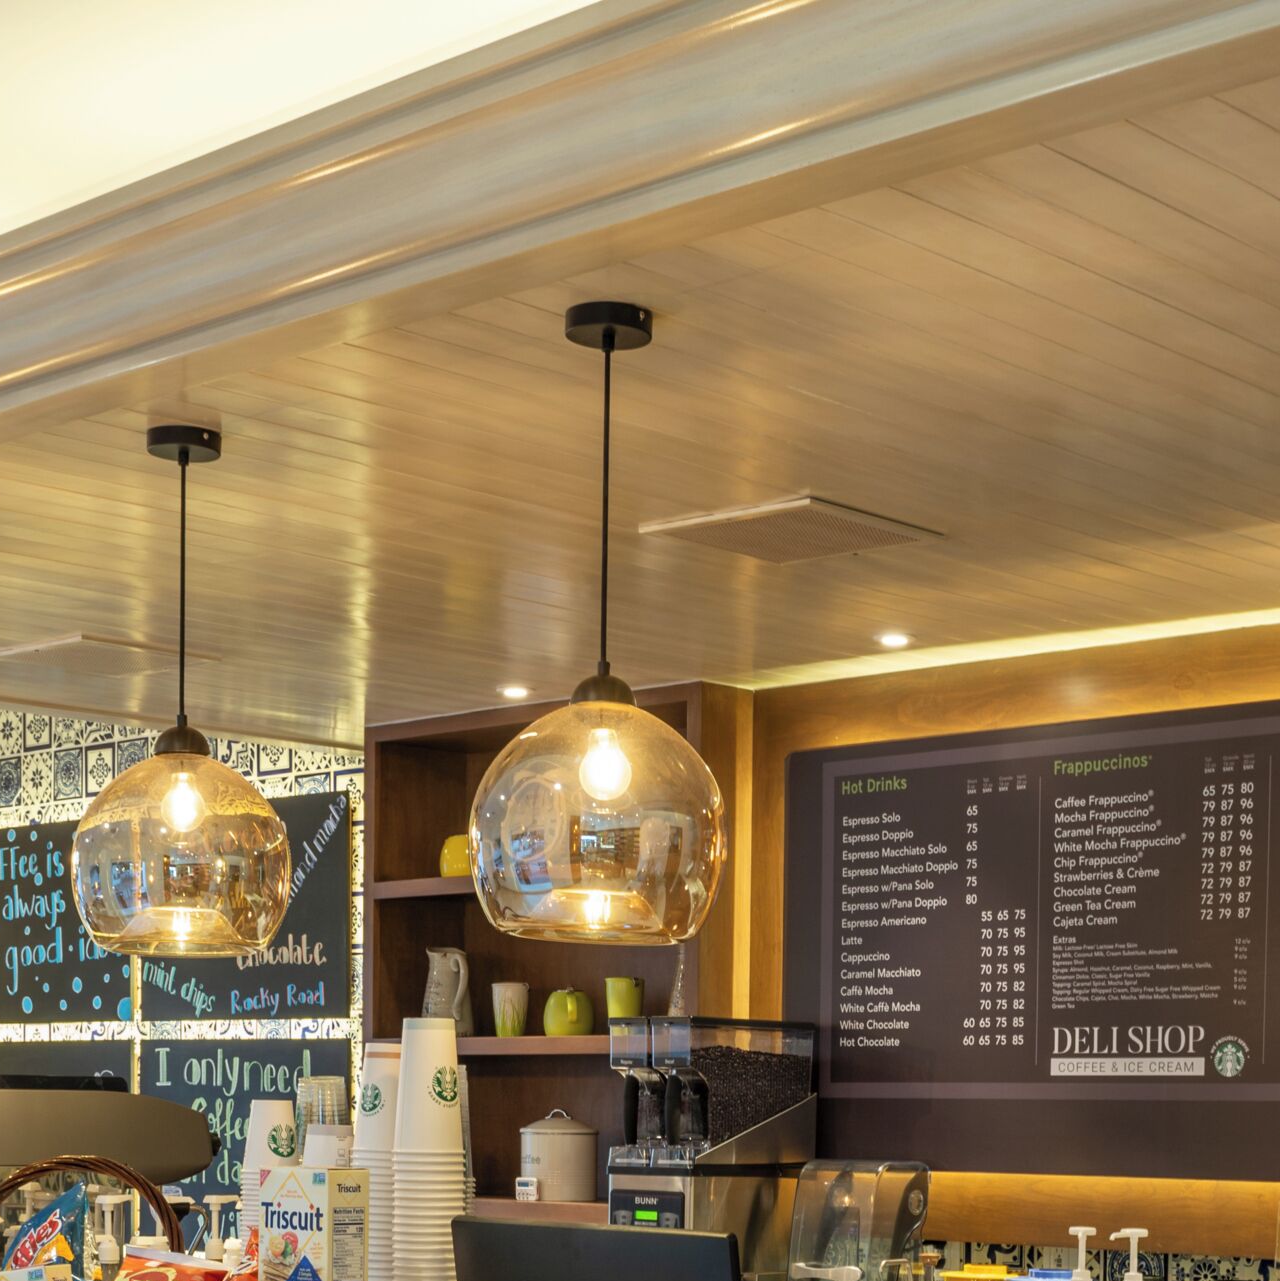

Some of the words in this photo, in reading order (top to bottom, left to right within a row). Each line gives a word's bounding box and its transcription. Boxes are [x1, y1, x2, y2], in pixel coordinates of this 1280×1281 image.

[842, 781, 862, 795] Hot
[867, 777, 907, 793] Drinks
[843, 816, 879, 828] Espresso
[882, 812, 900, 823] Solo
[843, 833, 879, 845] Espresso
[882, 829, 913, 842] Doppio
[47, 841, 64, 878] is
[843, 850, 879, 862] Espresso
[882, 845, 925, 857] Macchiato
[928, 844, 947, 854] Solo
[843, 867, 878, 879] Espresso
[881, 863, 923, 875] Macchiato
[926, 861, 958, 874] Doppio
[1054, 871, 1113, 883] Strawberries
[1117, 869, 1124, 878] &
[1127, 867, 1159, 877] Crème
[842, 884, 879, 896] Espresso
[881, 881, 912, 892] w/Pana
[915, 880, 934, 890] Solo
[1054, 885, 1101, 897] Chocolate
[1105, 884, 1136, 894] Cream
[2, 884, 65, 930] always
[842, 901, 878, 913] Espresso
[882, 899, 912, 909] w/Pana
[915, 897, 947, 909] Doppio
[1054, 901, 1082, 912] Green
[1085, 900, 1101, 910] Tea
[1105, 899, 1136, 909] Cream
[842, 919, 878, 930] Espresso
[881, 916, 927, 926] Americano
[1053, 916, 1083, 929] Cajeta
[1086, 915, 1117, 925] Cream
[841, 936, 862, 945] Latte
[5, 927, 63, 995] good
[841, 952, 890, 965] Cappuccino
[841, 969, 875, 979] Caramel
[878, 968, 921, 978] Macchiato
[143, 961, 176, 994] mint
[180, 977, 215, 1018] chips
[841, 986, 862, 996] Caffè
[865, 985, 893, 995] Mocha
[231, 987, 280, 1016] Rocky
[287, 981, 325, 1007] Road
[840, 1003, 864, 1013] White
[867, 1002, 889, 1012] Caffè
[892, 1001, 920, 1011] Mocha
[840, 1020, 864, 1030] White
[867, 1019, 909, 1029] Chocolate
[840, 1037, 855, 1046] Hot
[858, 1037, 900, 1046] Chocolate
[1053, 1026, 1119, 1054] DELI
[1128, 1025, 1204, 1053] SHOP
[155, 1048, 171, 1086] I
[184, 1049, 239, 1097] only
[1059, 1062, 1106, 1072] COFFEE
[1112, 1062, 1118, 1072] &
[1124, 1062, 1143, 1072] ICE
[1149, 1062, 1194, 1072] CREAM
[337, 1184, 361, 1193] Triscuit
[635, 1197, 657, 1205] BUNN
[261, 1202, 323, 1232] Triscuit
